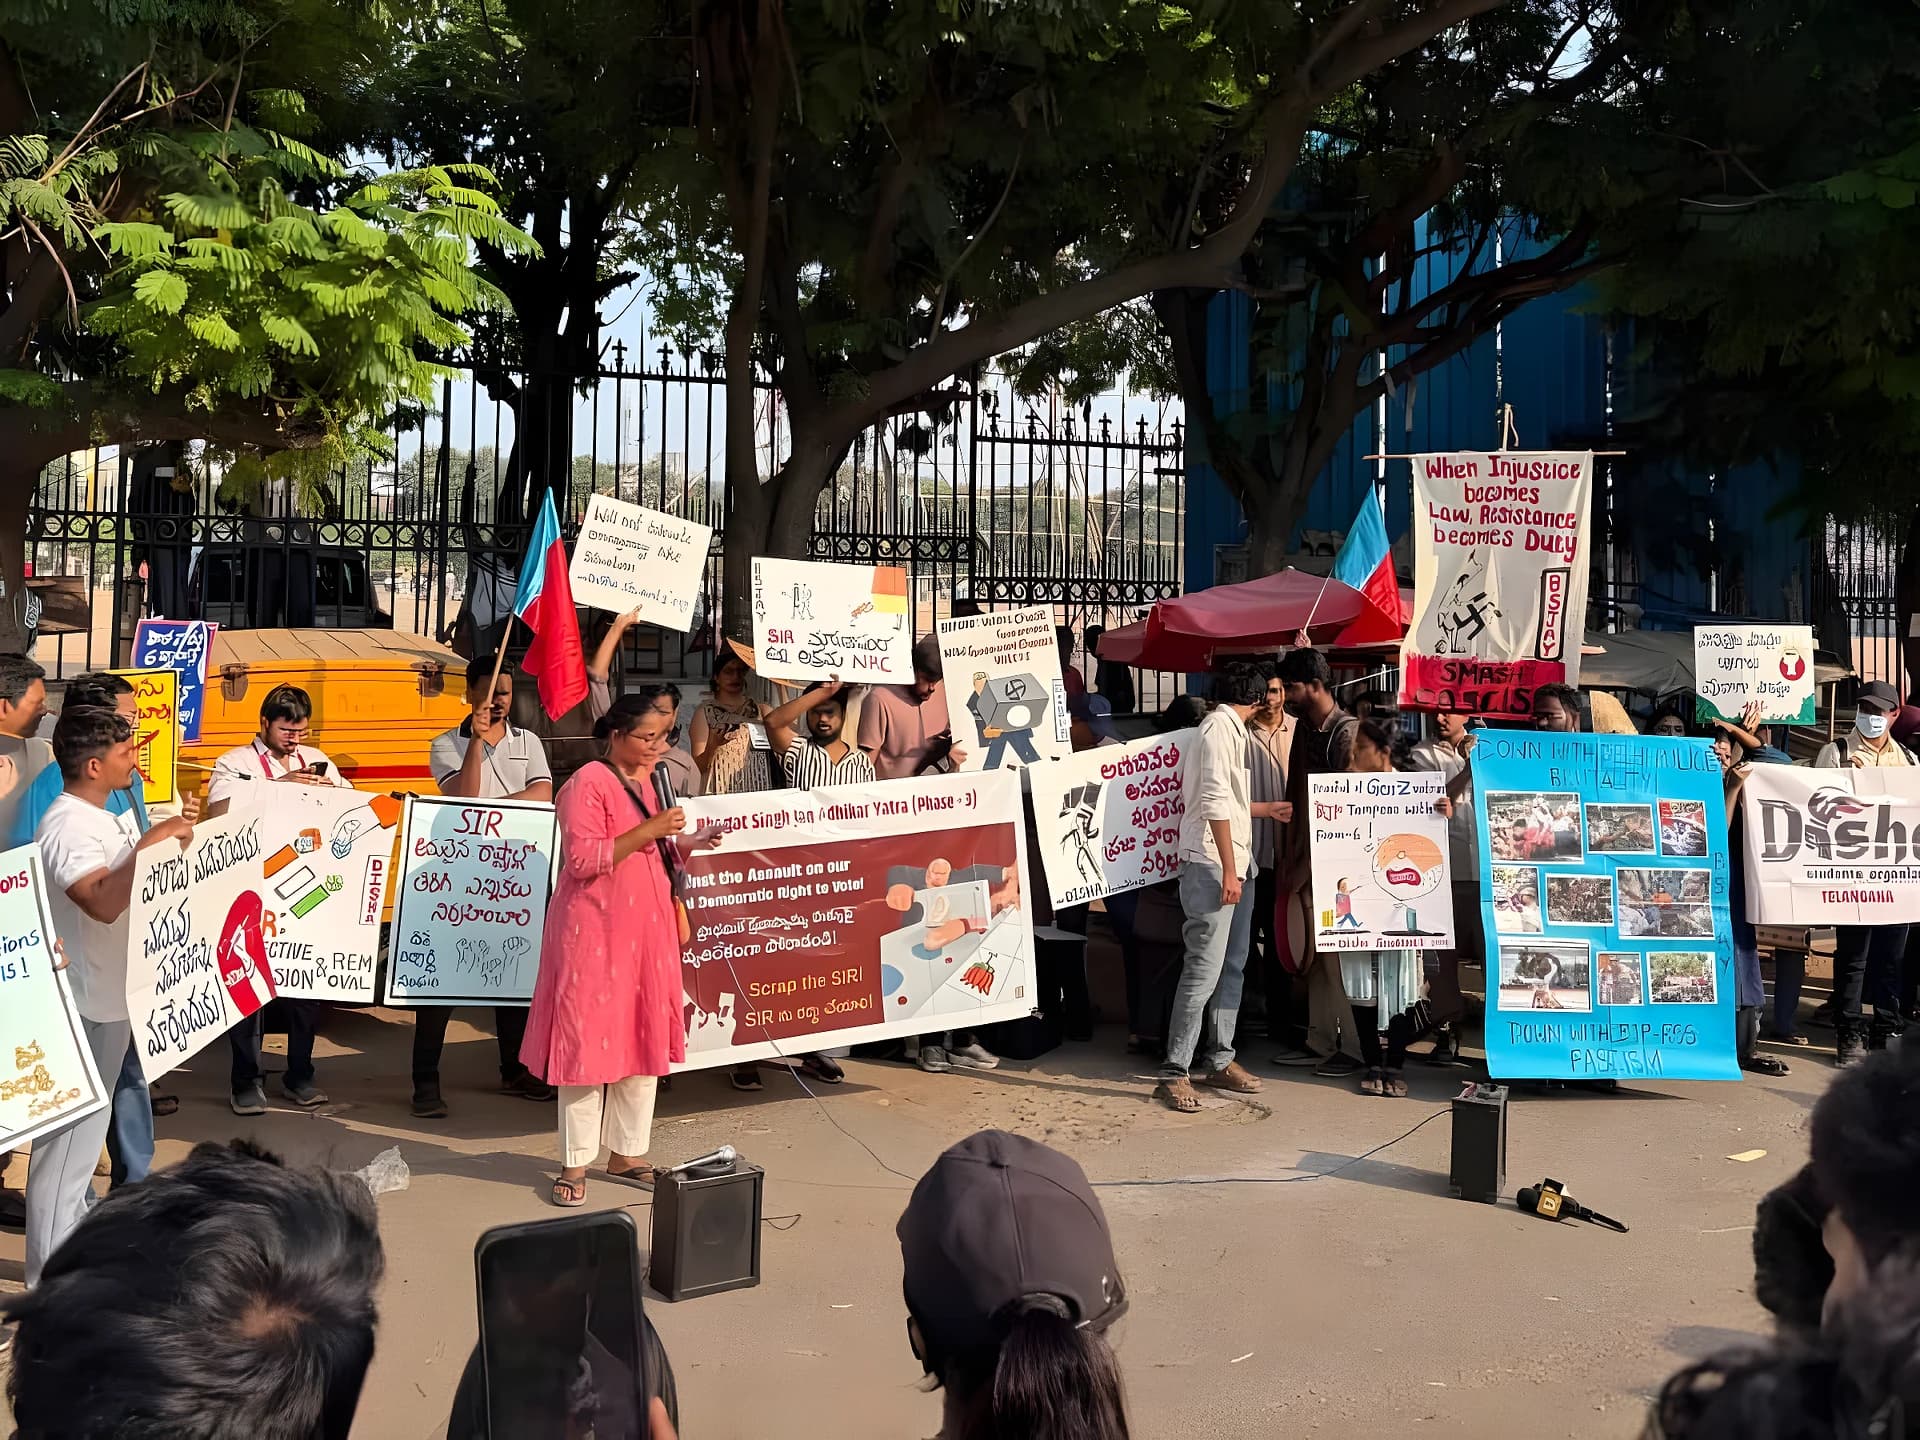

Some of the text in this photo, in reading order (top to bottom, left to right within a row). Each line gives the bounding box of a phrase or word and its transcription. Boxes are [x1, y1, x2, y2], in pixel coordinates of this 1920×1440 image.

[1426, 455, 1581, 484] When Injustice
[1429, 502, 1577, 529] Law, Resistance
[1434, 523, 1514, 547] becomes
[1440, 662, 1524, 685] SMASH
[453, 808, 503, 838] SIR
[751, 808, 791, 831] Singh
[875, 797, 909, 817] Yatra
[1757, 793, 1920, 864] Dish
[805, 863, 824, 876] on
[827, 860, 851, 873] our
[316, 952, 373, 978] & REM
[274, 968, 371, 990] SION OVAL
[745, 1009, 774, 1028] SIR
